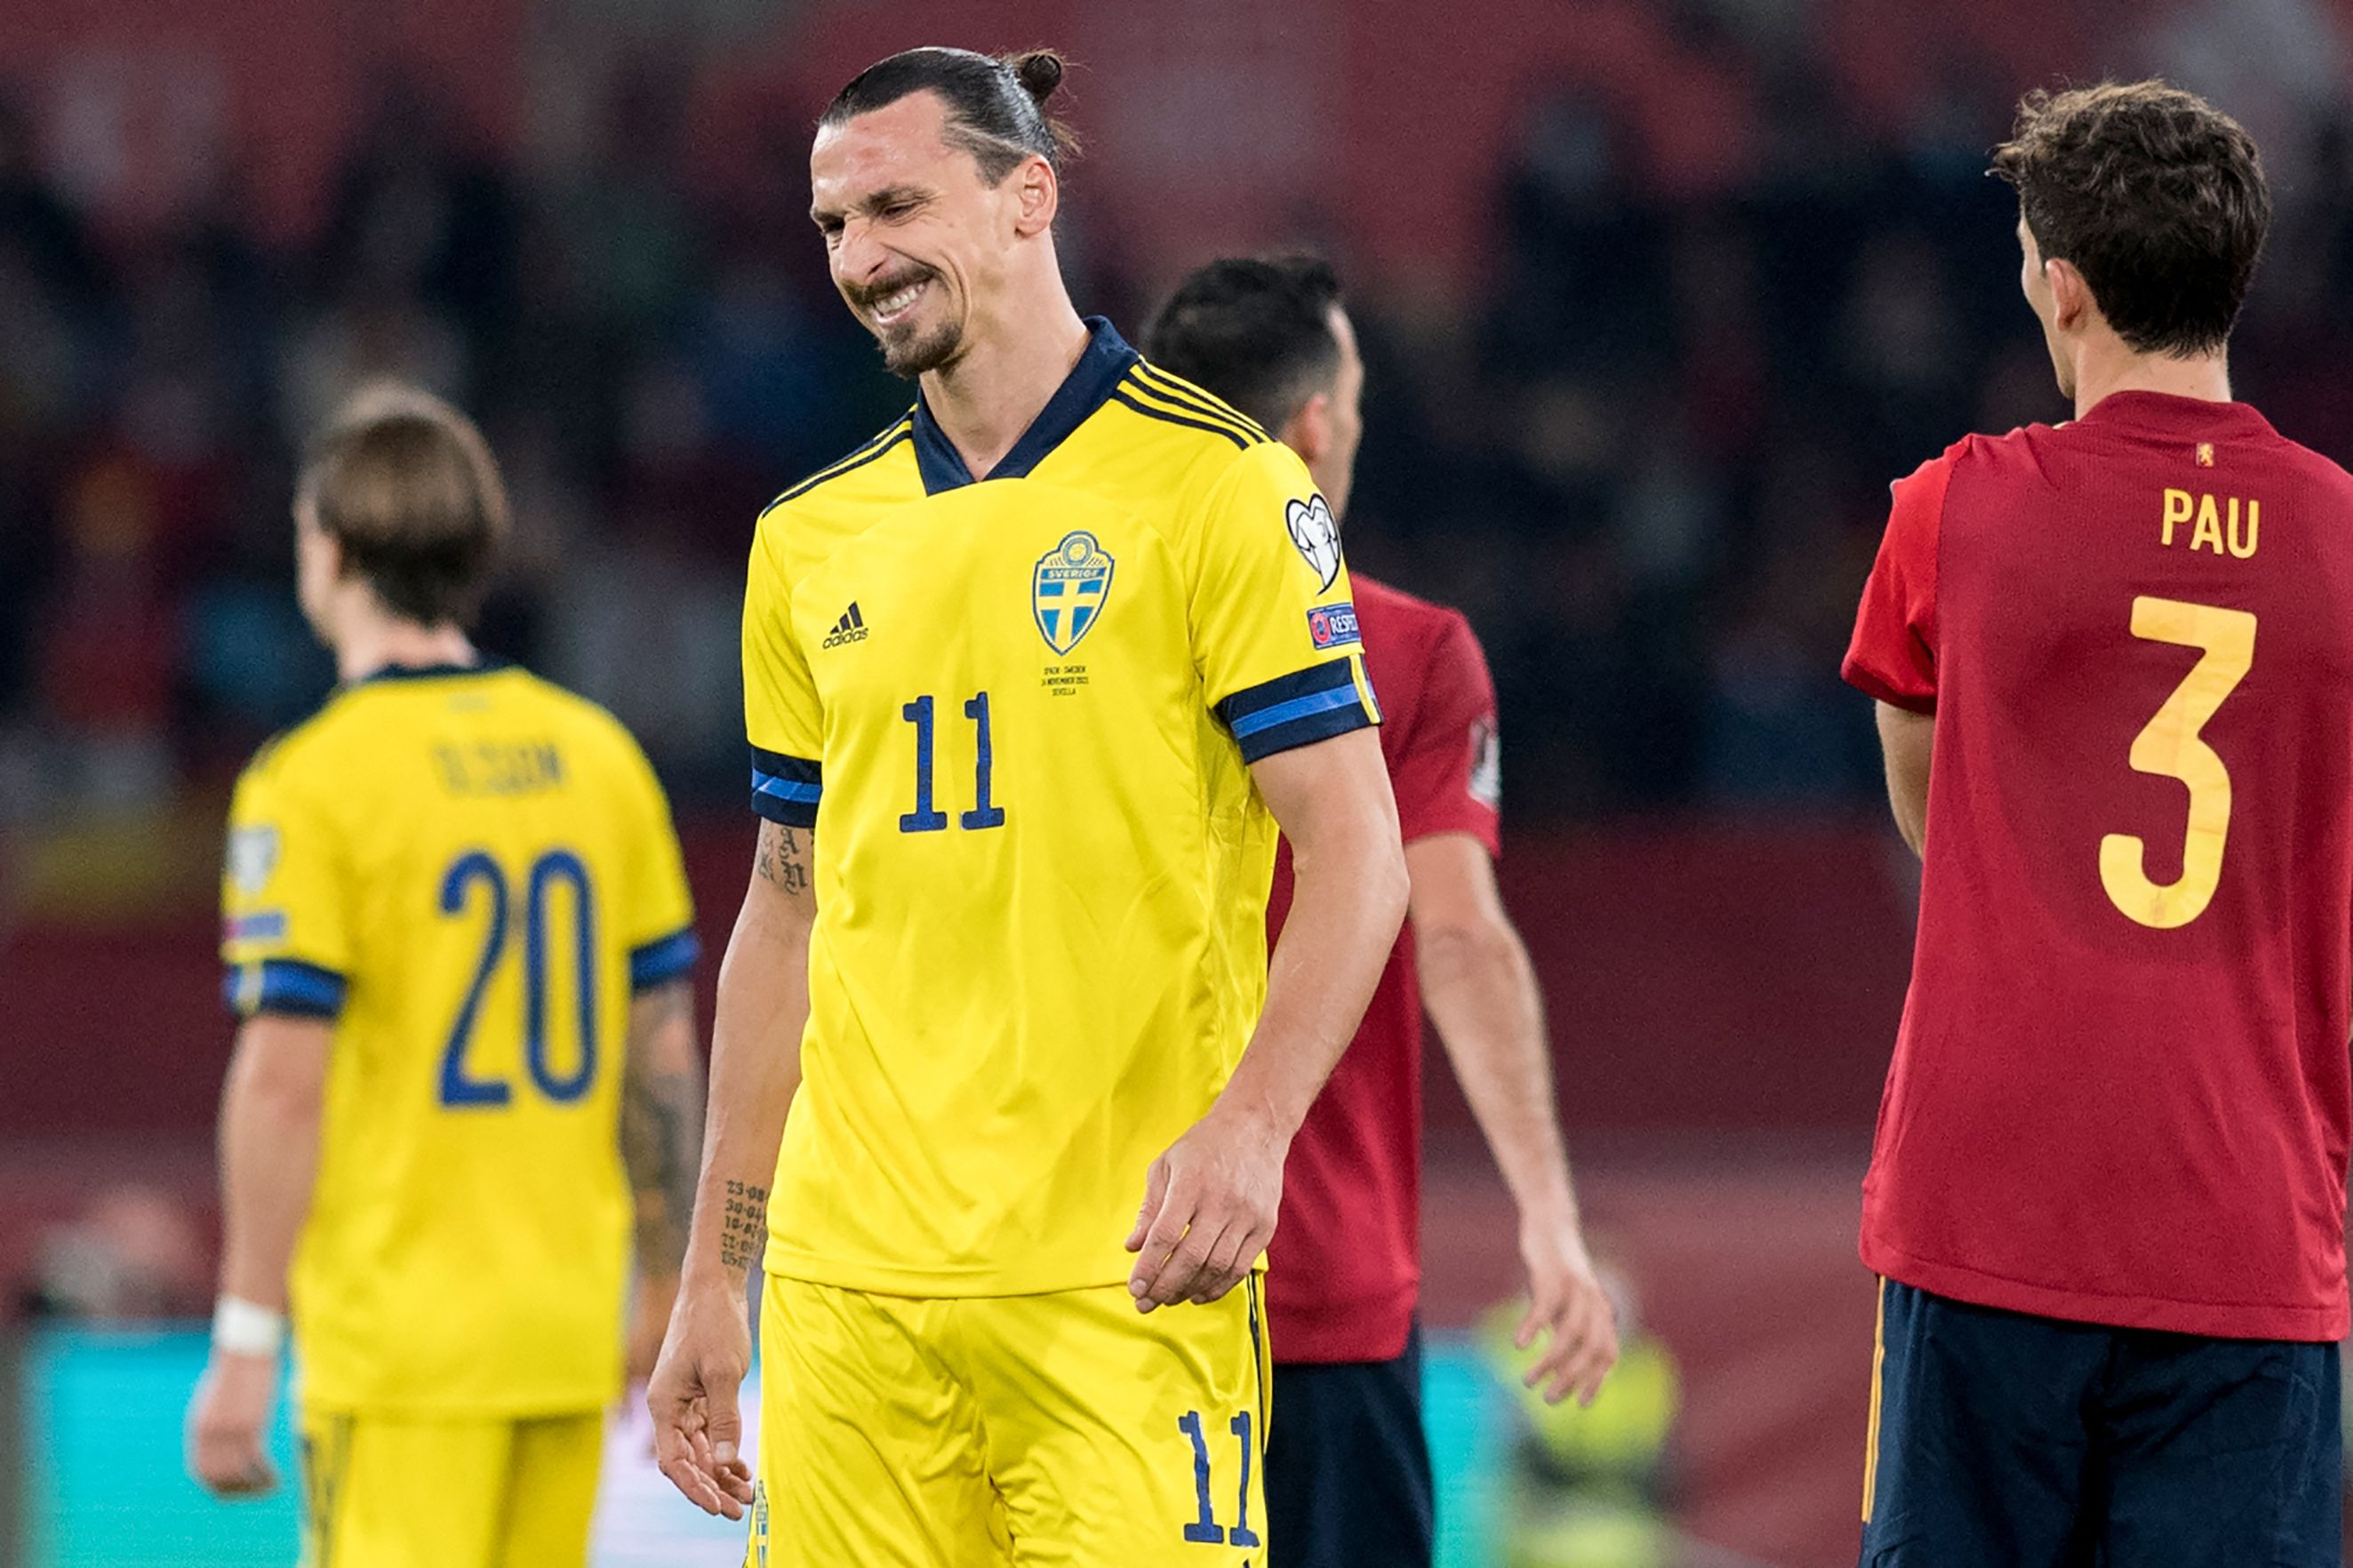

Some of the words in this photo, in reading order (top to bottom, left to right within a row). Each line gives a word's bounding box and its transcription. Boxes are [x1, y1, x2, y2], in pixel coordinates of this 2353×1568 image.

[1048, 569, 1098, 579] SVERIGE
[2161, 487, 2260, 559] PAU
[822, 627, 868, 650] adidas
[899, 691, 1005, 833] 11
[2098, 595, 2258, 930] 3
[440, 851, 597, 1108] 20
[1178, 1410, 1261, 1547] 11
